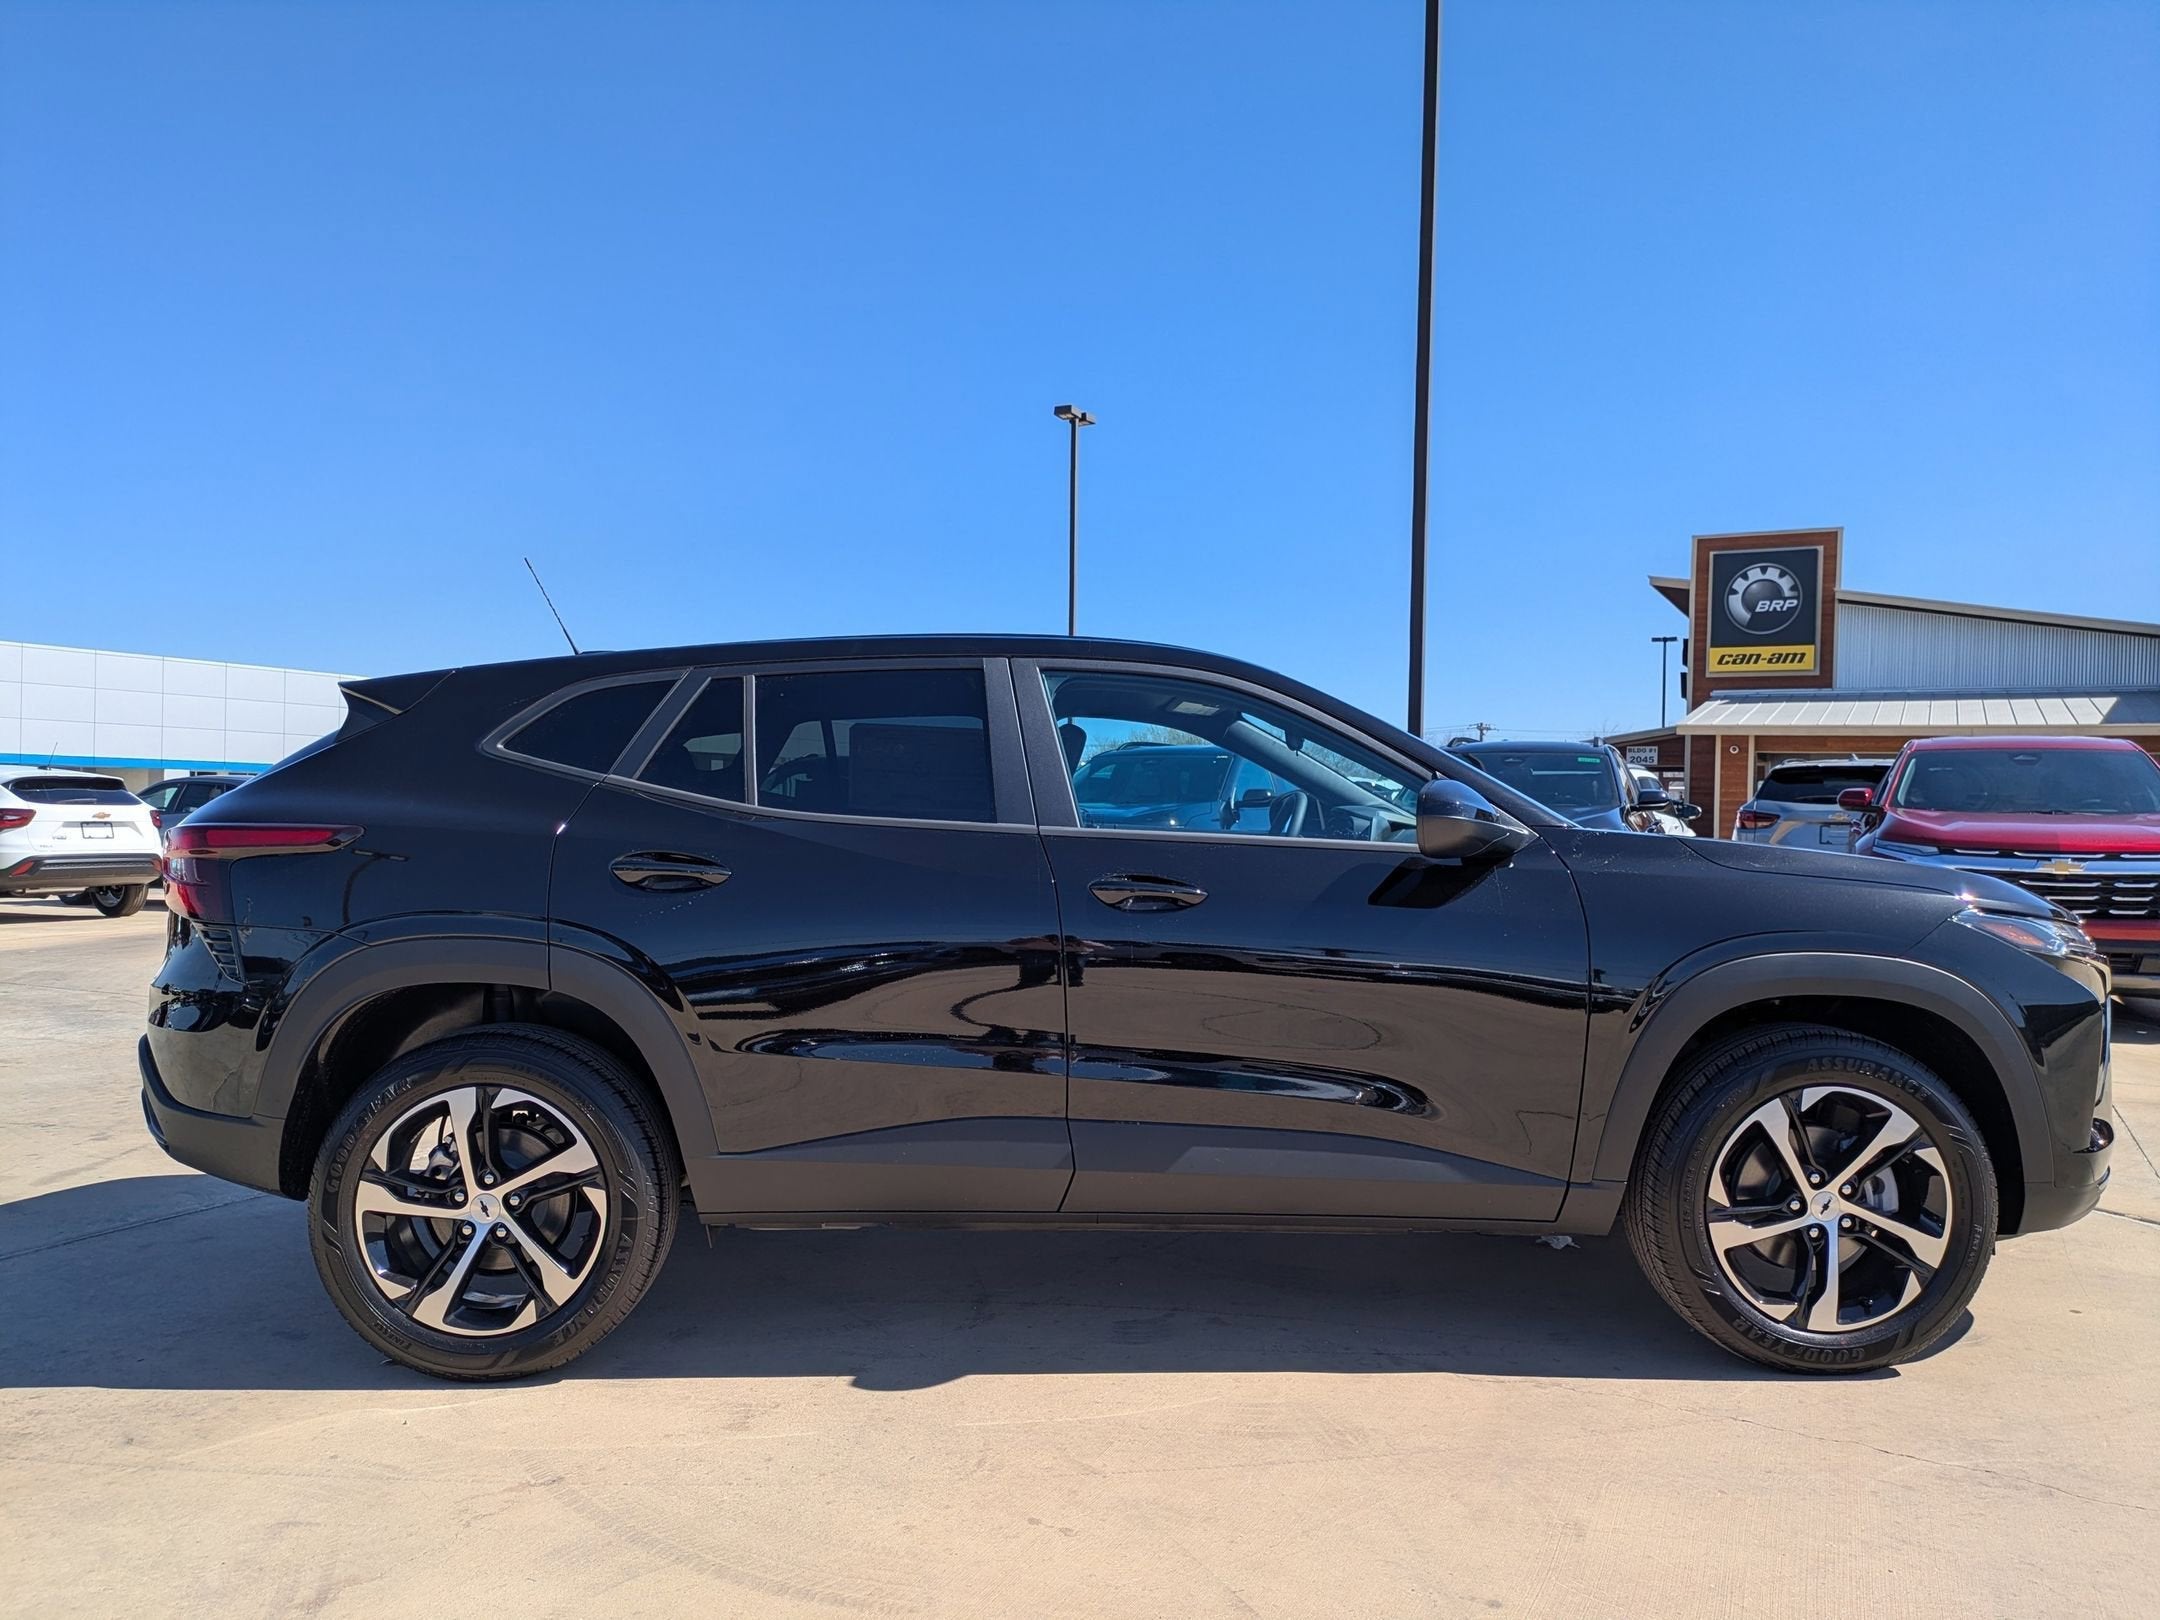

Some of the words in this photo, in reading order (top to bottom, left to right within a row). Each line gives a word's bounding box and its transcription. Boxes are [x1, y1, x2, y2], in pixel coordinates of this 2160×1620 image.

[1755, 599, 1798, 612] BRP
[1717, 652, 1806, 665] can-am
[1629, 755, 1655, 764] 2045
